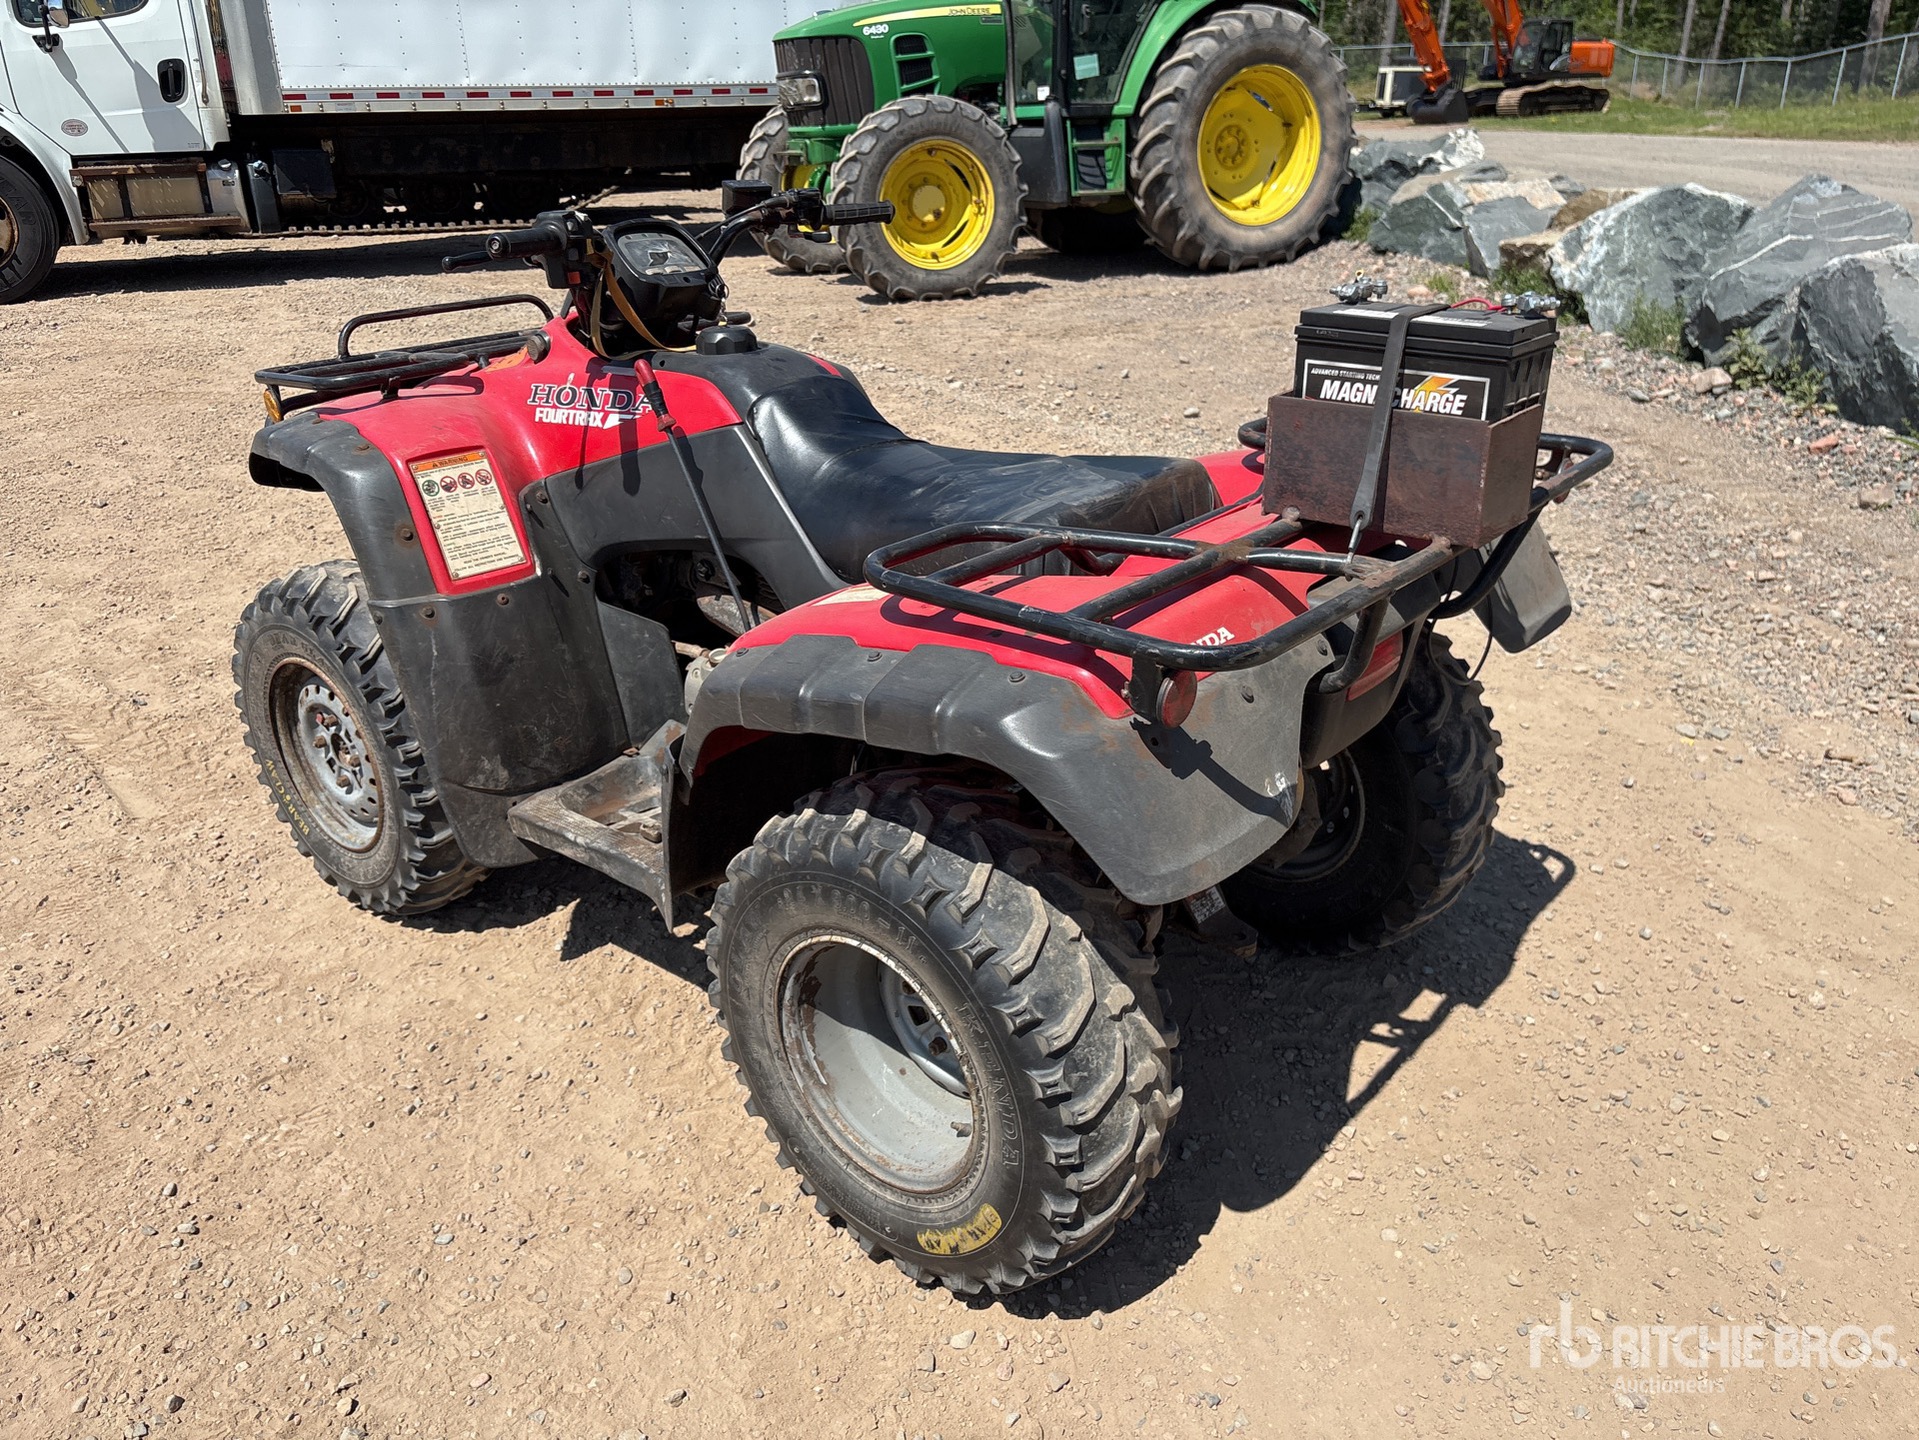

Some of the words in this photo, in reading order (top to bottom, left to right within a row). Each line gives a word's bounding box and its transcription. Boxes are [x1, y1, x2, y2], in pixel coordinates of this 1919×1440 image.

[949, 8, 966, 16] JOHN
[966, 7, 990, 15] DEERE
[863, 24, 889, 35] 6430
[1311, 367, 1339, 377] ADVANCED
[1340, 370, 1365, 380] STARTING
[527, 383, 654, 414] HONDA
[535, 407, 604, 428] FOURTRAX
[265, 759, 285, 794] CLAW
[288, 803, 311, 836] BEAR
